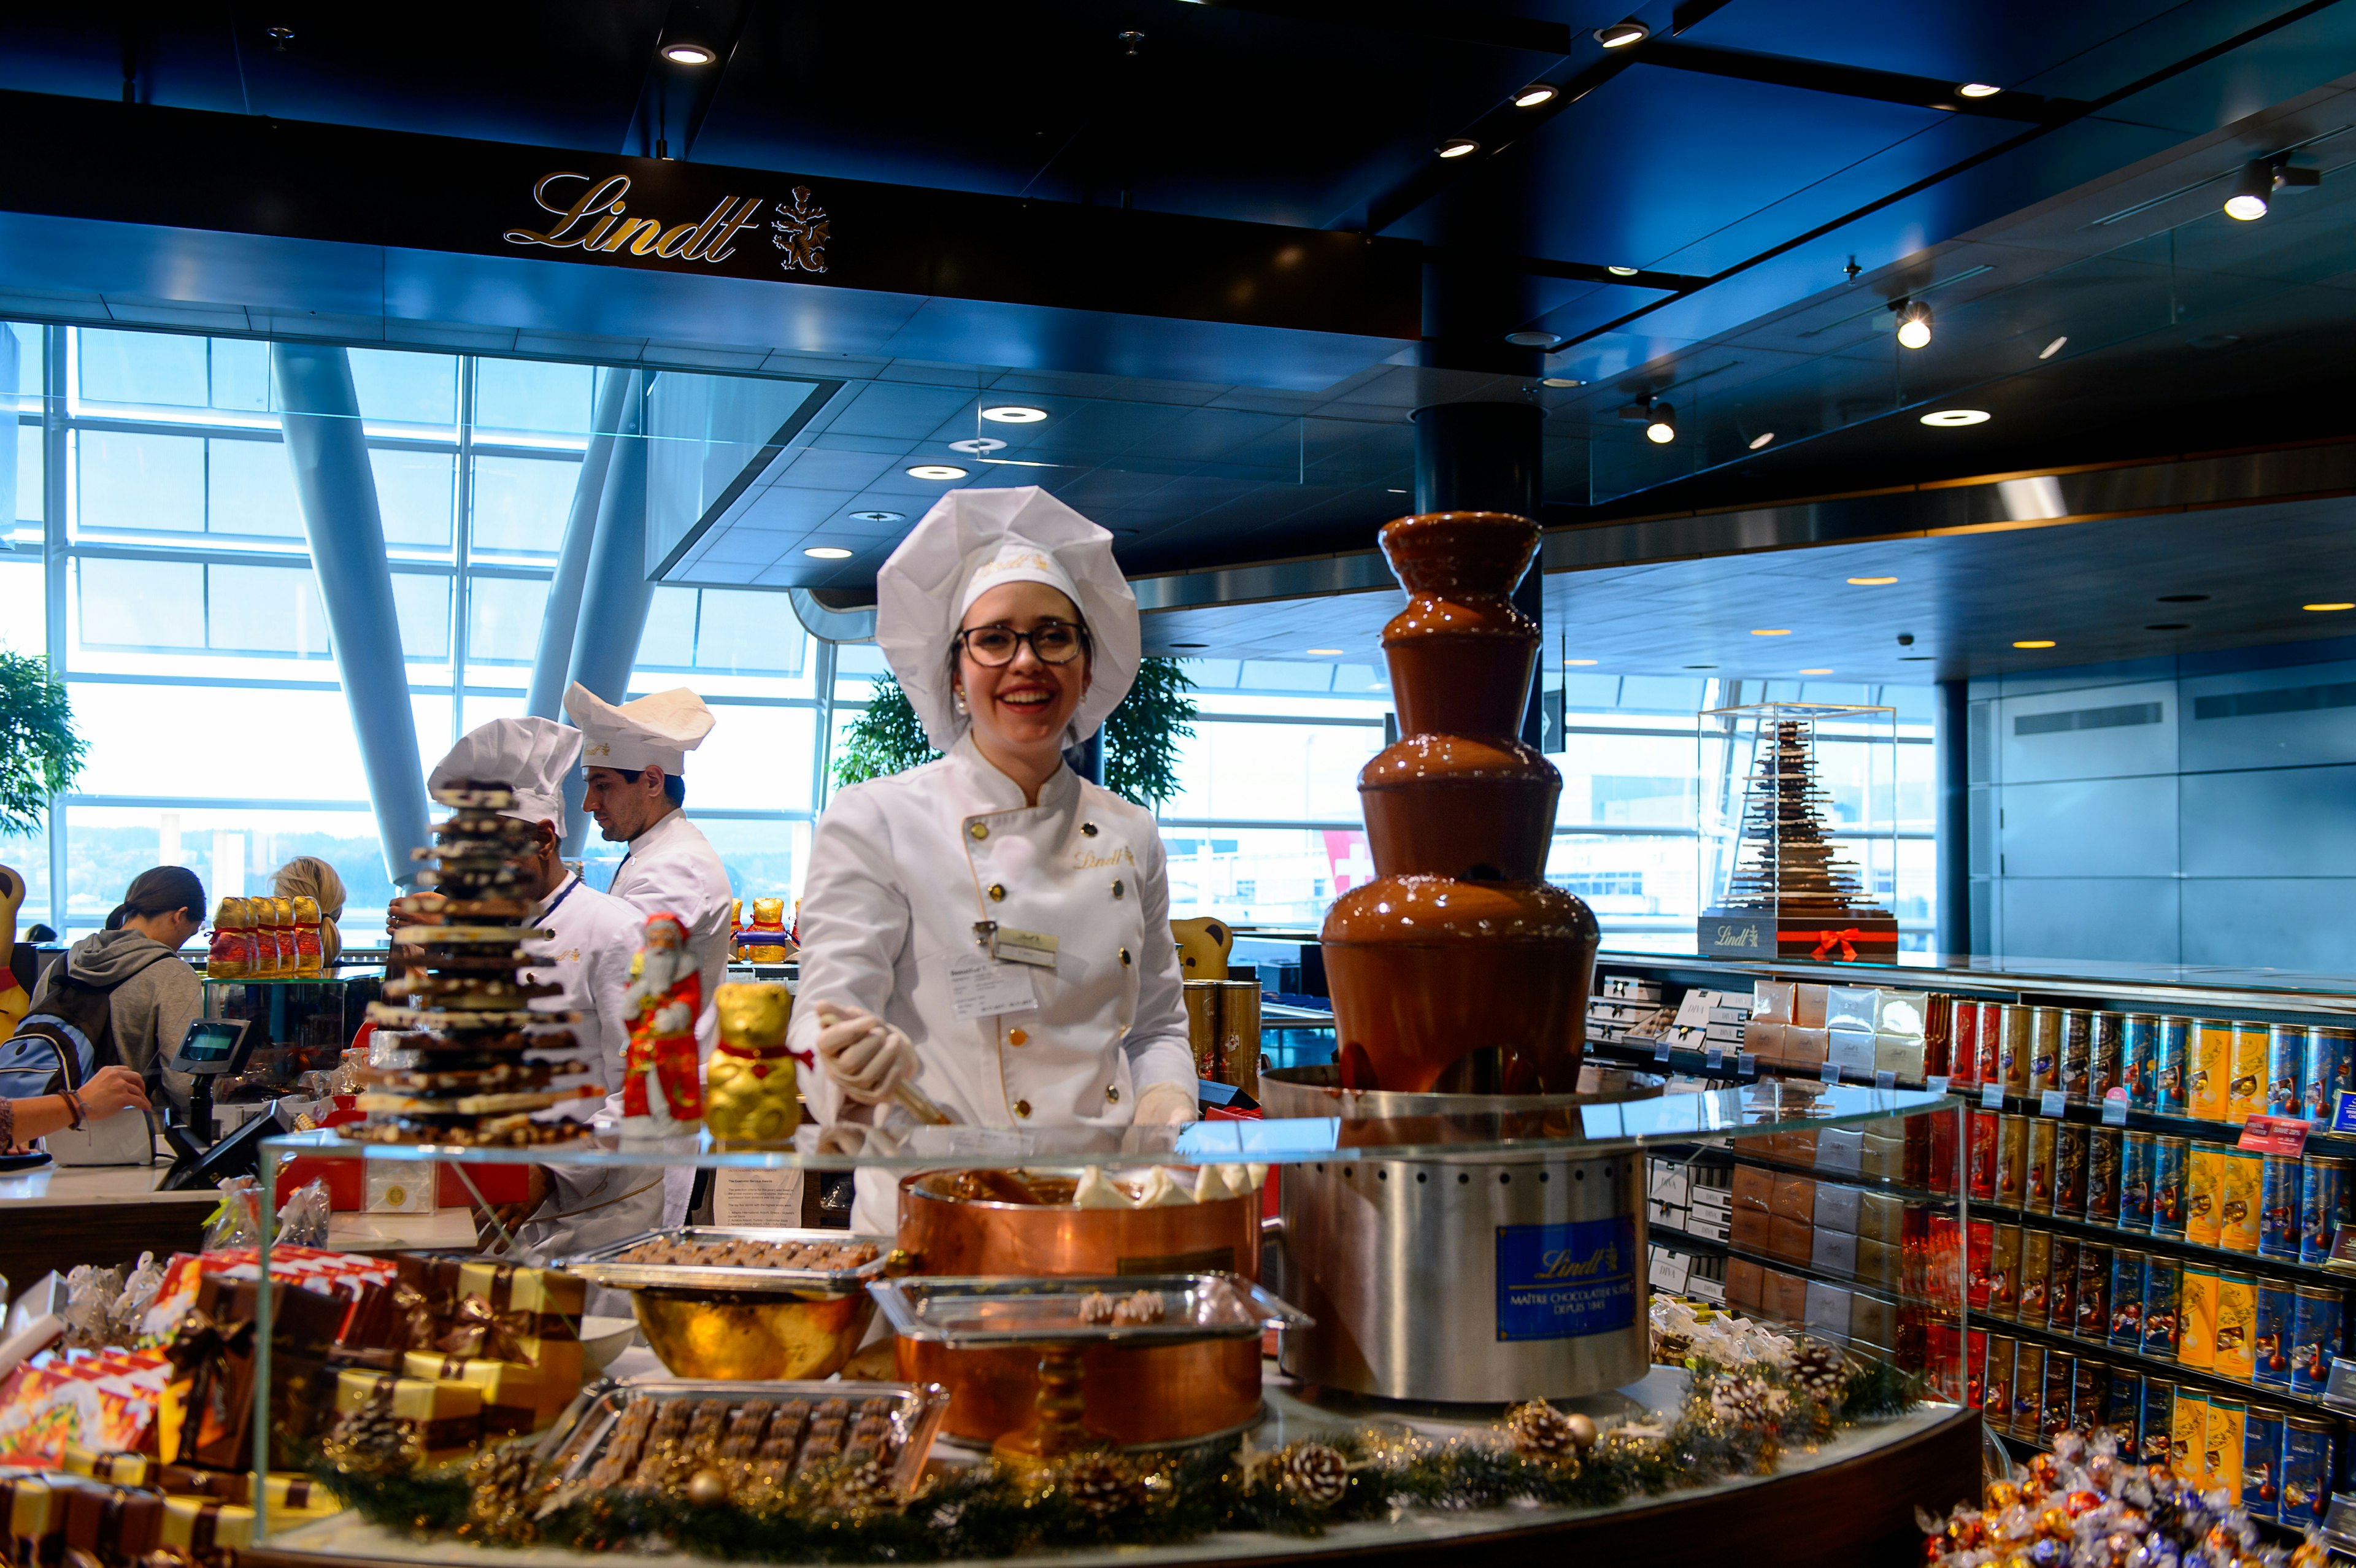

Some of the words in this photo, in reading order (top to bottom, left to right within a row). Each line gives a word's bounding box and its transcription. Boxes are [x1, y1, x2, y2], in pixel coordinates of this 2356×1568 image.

[503, 171, 763, 263] Lindt
[1072, 848, 1123, 870] Lindt
[1714, 925, 1749, 947] Lindt
[1661, 1177, 1676, 1189] DIVA
[1534, 1248, 1605, 1279] Lindt
[1660, 1265, 1676, 1278] DIVA
[1550, 1287, 1611, 1304] CHOCOLATIER
[1553, 1302, 1585, 1315] DEPUIS
[2292, 1445, 2315, 1455] LINDOR
